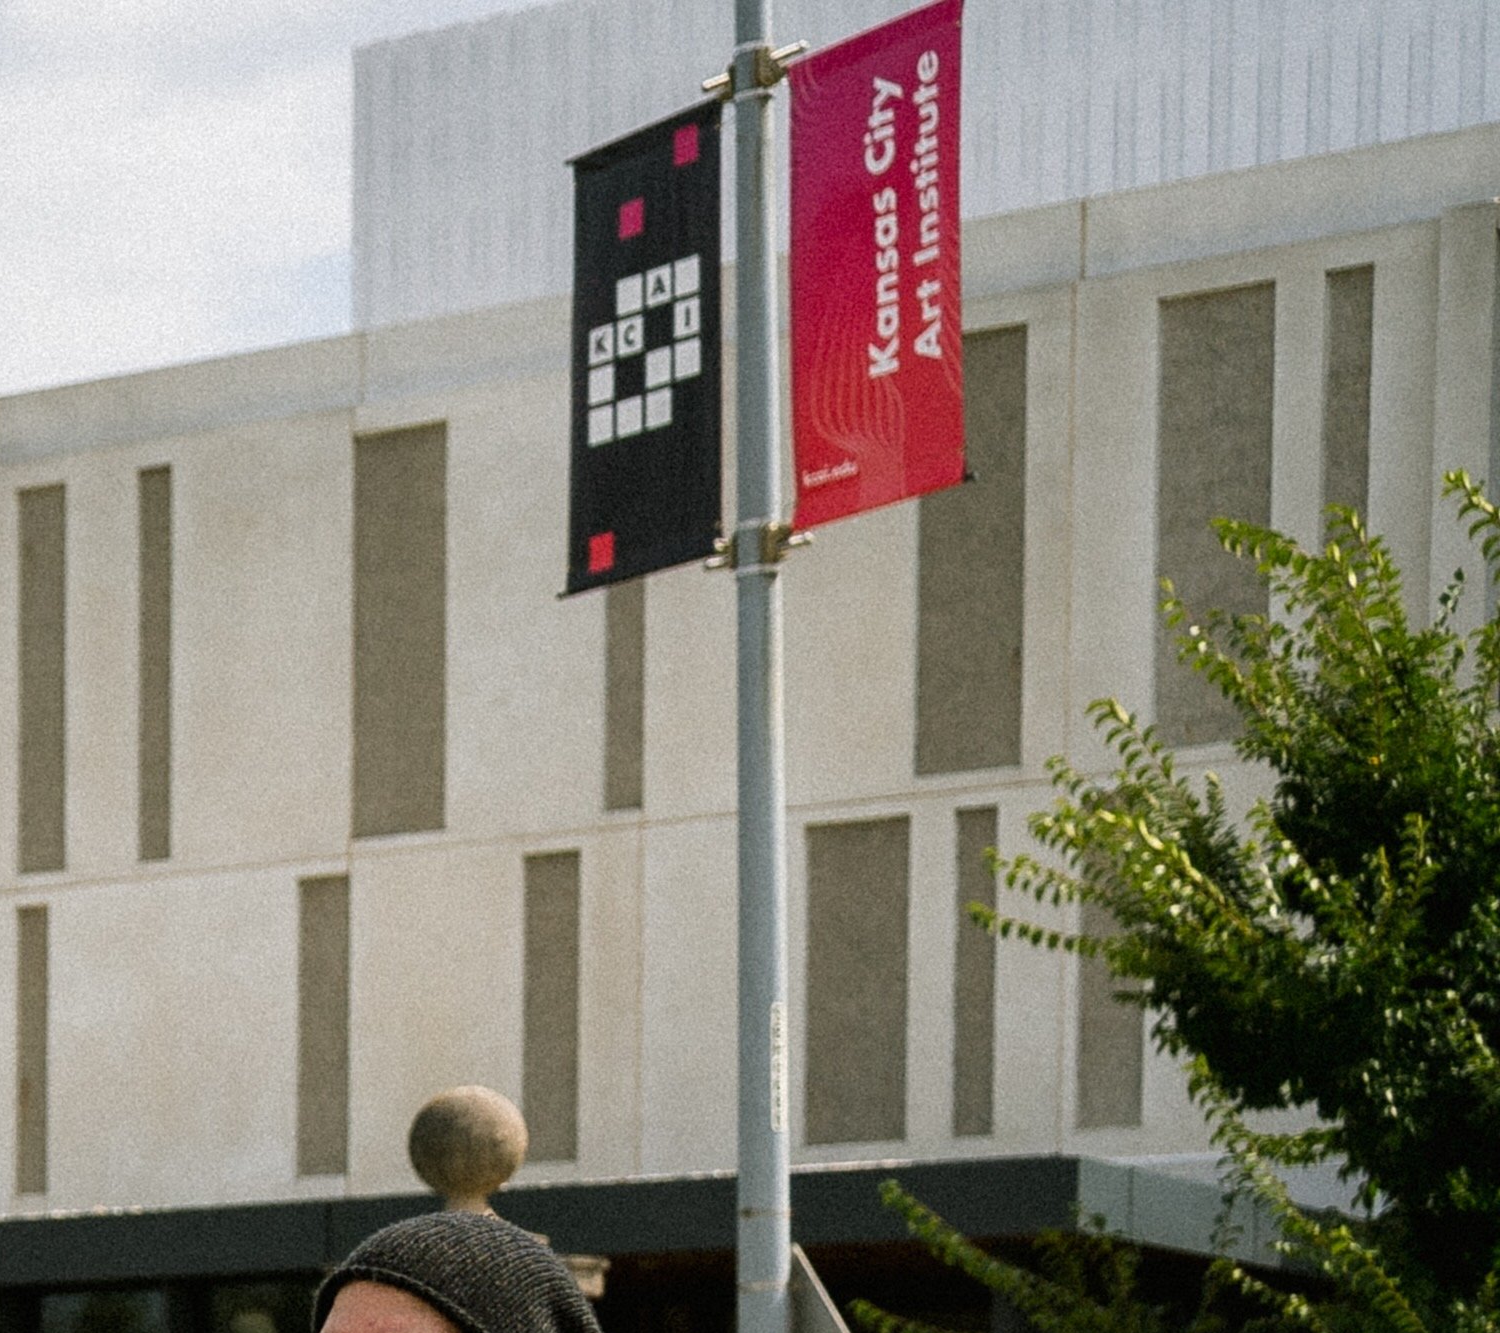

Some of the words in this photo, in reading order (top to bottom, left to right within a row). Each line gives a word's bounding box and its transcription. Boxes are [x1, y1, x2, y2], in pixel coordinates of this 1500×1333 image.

[864, 76, 903, 176] City
[910, 50, 940, 267] Institute
[867, 186, 899, 379] Kansas
[913, 279, 943, 359] Art
